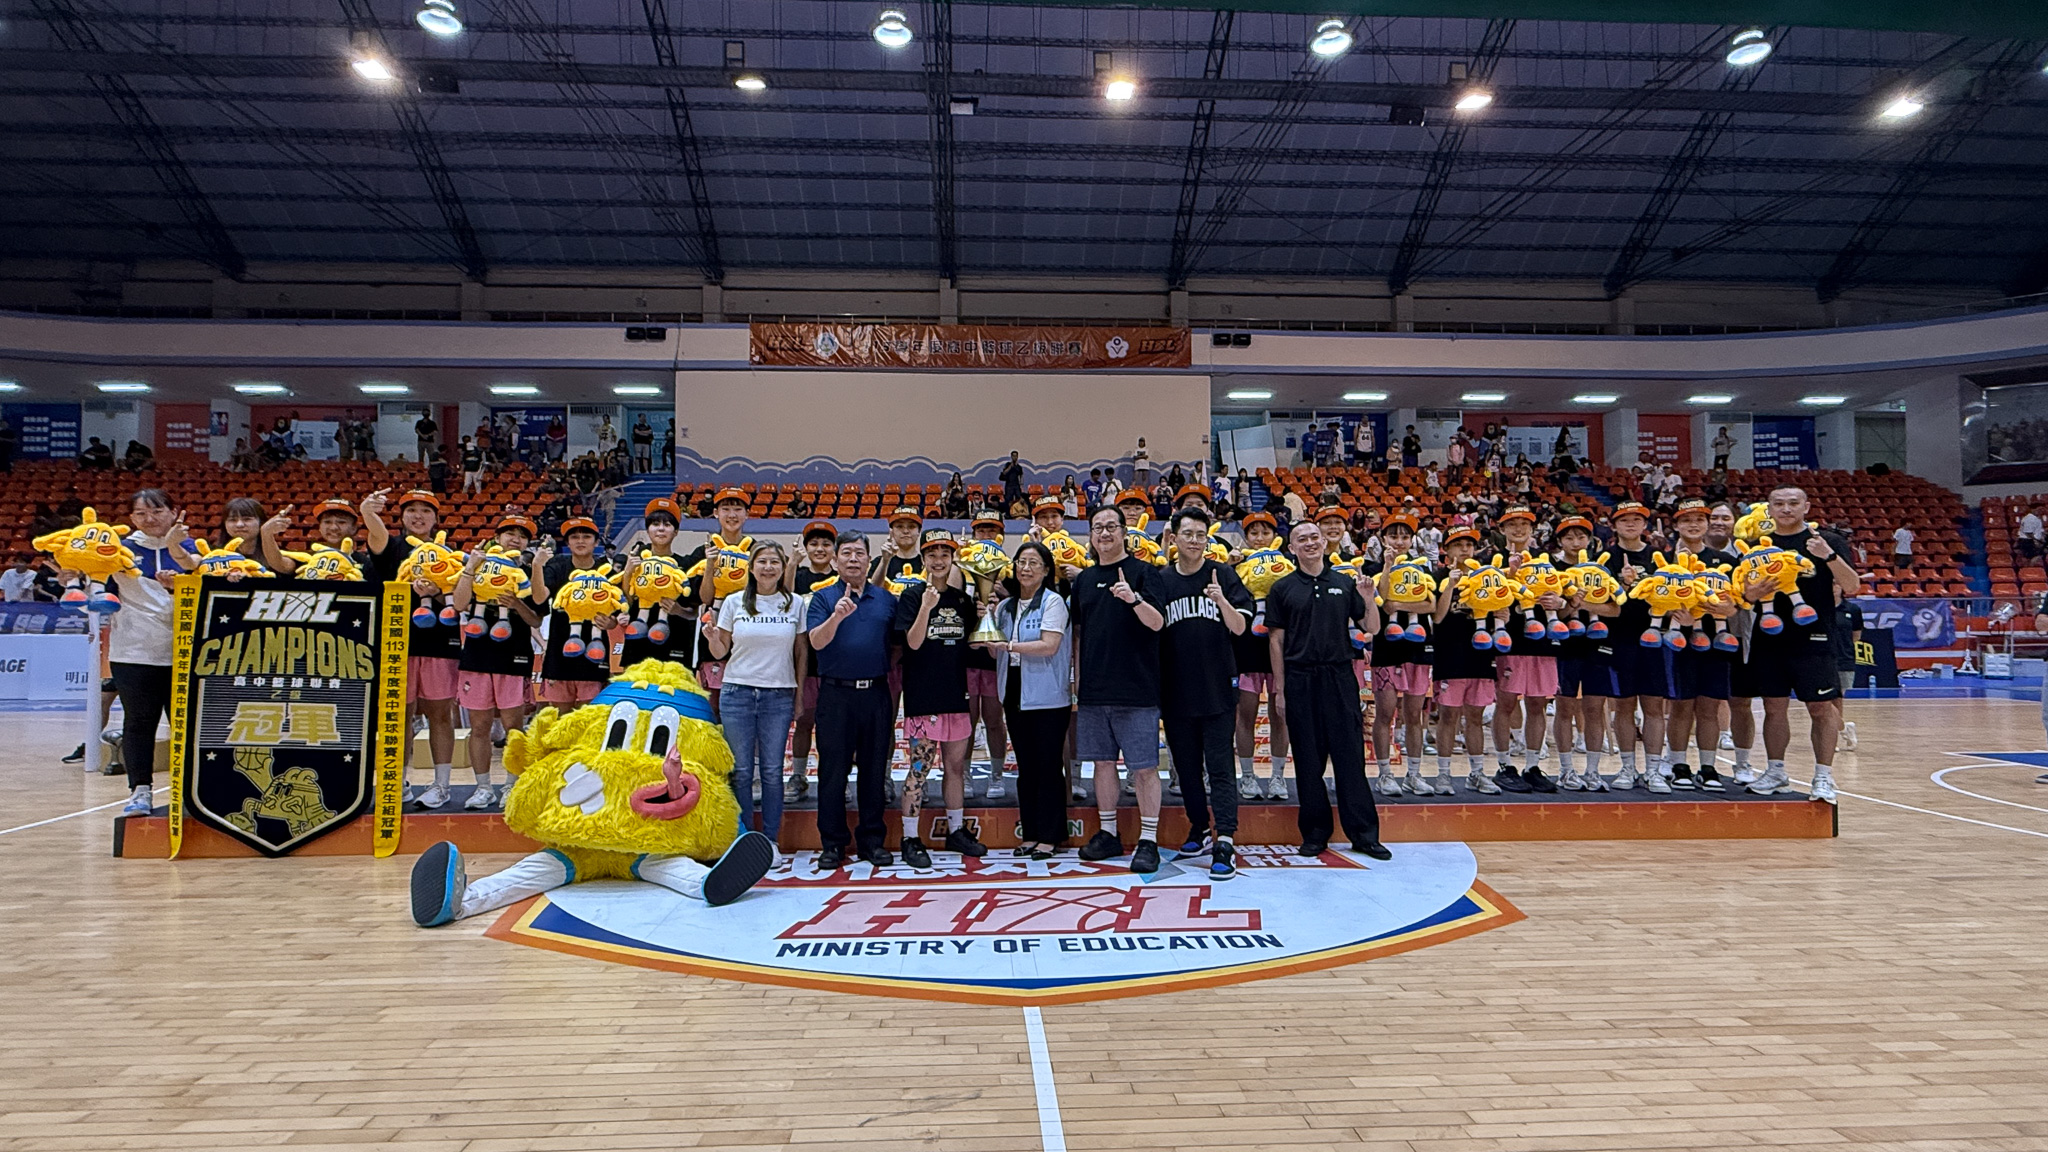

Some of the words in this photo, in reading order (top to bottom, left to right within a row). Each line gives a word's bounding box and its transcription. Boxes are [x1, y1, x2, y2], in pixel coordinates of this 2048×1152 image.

[243, 590, 341, 623] HBL
[194, 626, 375, 680] CHAMPIONS
[233, 676, 341, 689] 高中籃球聯賽
[270, 690, 302, 700] 乙級
[225, 701, 341, 746] 冠軍
[379, 592, 405, 840] 中華民國113學年度高中籃球聯賽乙級女生組冠軍
[932, 816, 982, 839] HL
[775, 939, 975, 958] MINISTRY
[993, 938, 1041, 953] OF
[1058, 934, 1285, 953] EDUCATION
